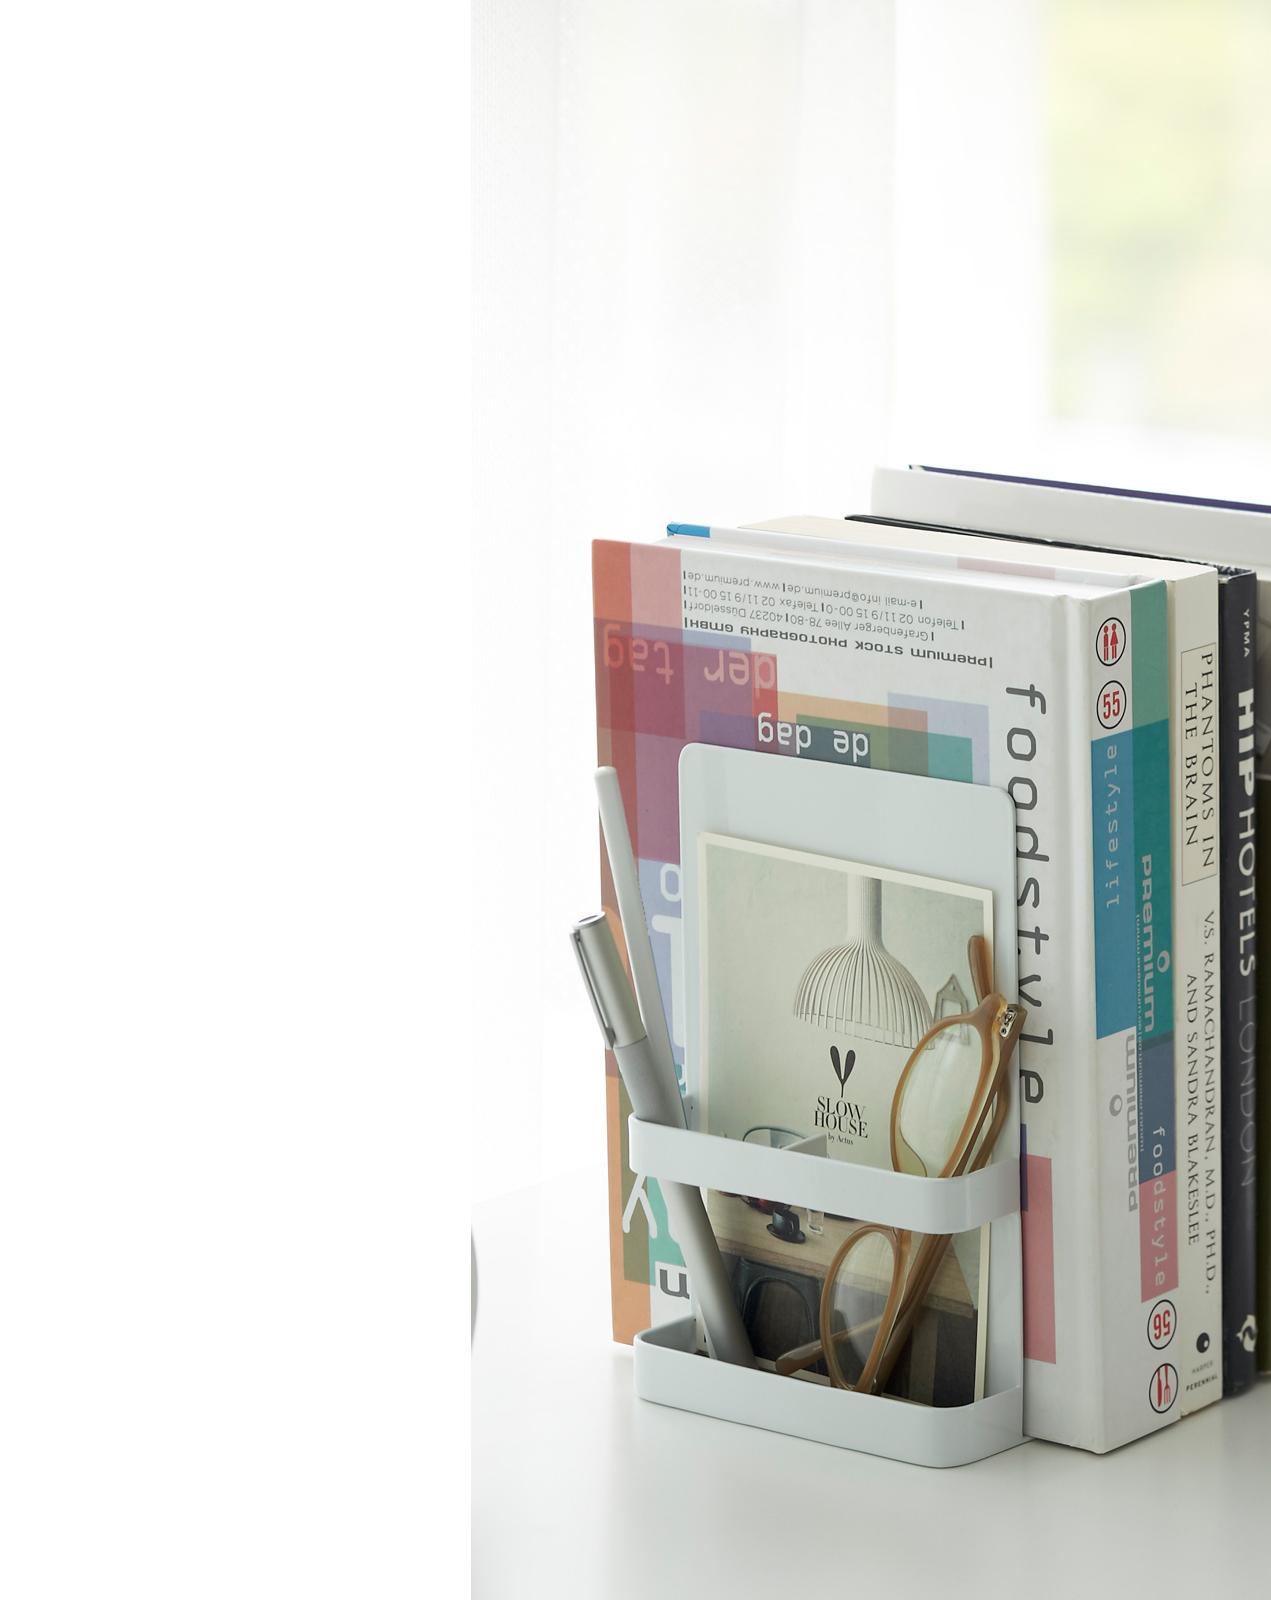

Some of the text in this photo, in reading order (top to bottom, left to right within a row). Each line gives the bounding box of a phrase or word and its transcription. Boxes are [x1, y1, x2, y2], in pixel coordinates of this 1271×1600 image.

[687, 571, 917, 608] e-mail info@premium.de www.premium.de
[719, 590, 732, 602] 15
[761, 596, 776, 607] 02
[779, 599, 819, 613] Telefax
[688, 600, 929, 642] Grafenberger Allee 78-80 40237 Düsseldorf
[856, 607, 868, 619] 15
[899, 613, 914, 625] 02
[917, 615, 959, 631] Telefon
[855, 640, 904, 655] STOCK
[1241, 608, 1251, 658] YPMA
[602, 623, 777, 698] der tag
[1103, 690, 1121, 720] 55
[757, 712, 870, 763] de dag
[1185, 682, 1199, 846] THE BRAIN
[1201, 652, 1215, 868] PHANTOMS IN
[1104, 744, 1121, 909] lifestyle
[1006, 683, 1053, 1104] foodstyle
[1203, 909, 1215, 945] V.S.
[1238, 687, 1256, 1187] HIP HOTELS LONDON
[814, 1110, 868, 1139] HOUSE
[816, 1095, 867, 1121] SLOW
[1186, 973, 1200, 1247] AND SANDRA BLAKESLEE
[1151, 1124, 1168, 1286] foodstyle
[1185, 1374, 1219, 1392] PERENNIAL
